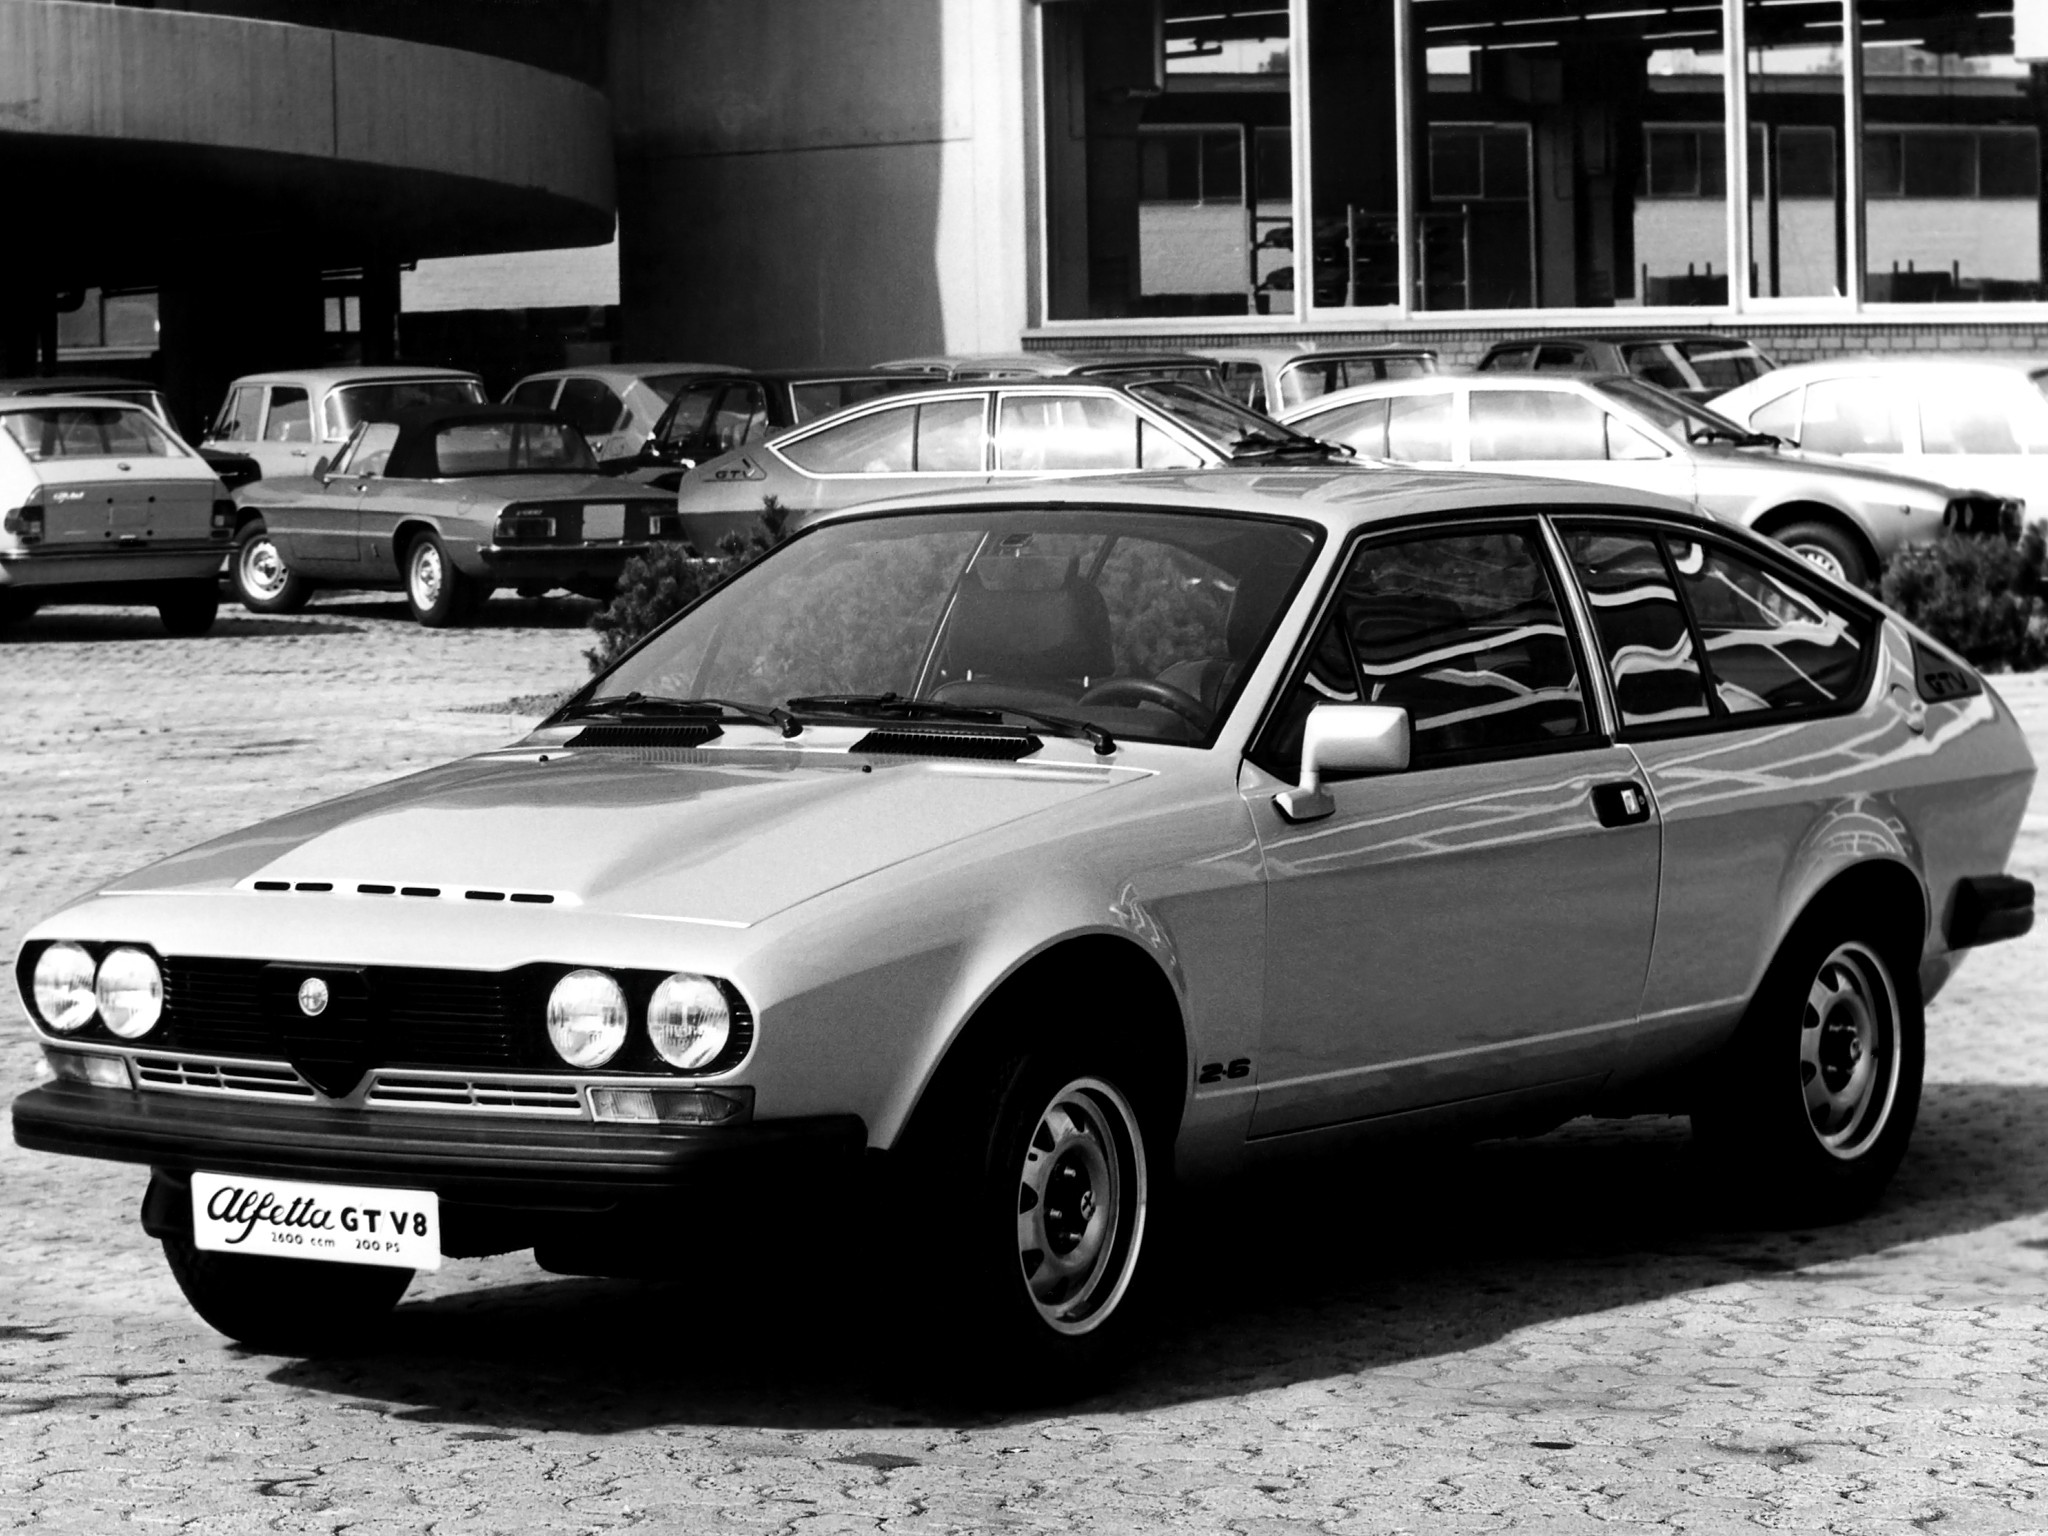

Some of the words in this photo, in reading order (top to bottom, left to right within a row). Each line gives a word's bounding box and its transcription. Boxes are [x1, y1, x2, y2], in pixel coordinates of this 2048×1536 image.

[207, 1186, 335, 1244] Alfetta
[271, 1231, 303, 1245] 2600
[310, 1237, 335, 1248] ccm
[355, 1238, 381, 1251] 200
[385, 1241, 400, 1253] PS
